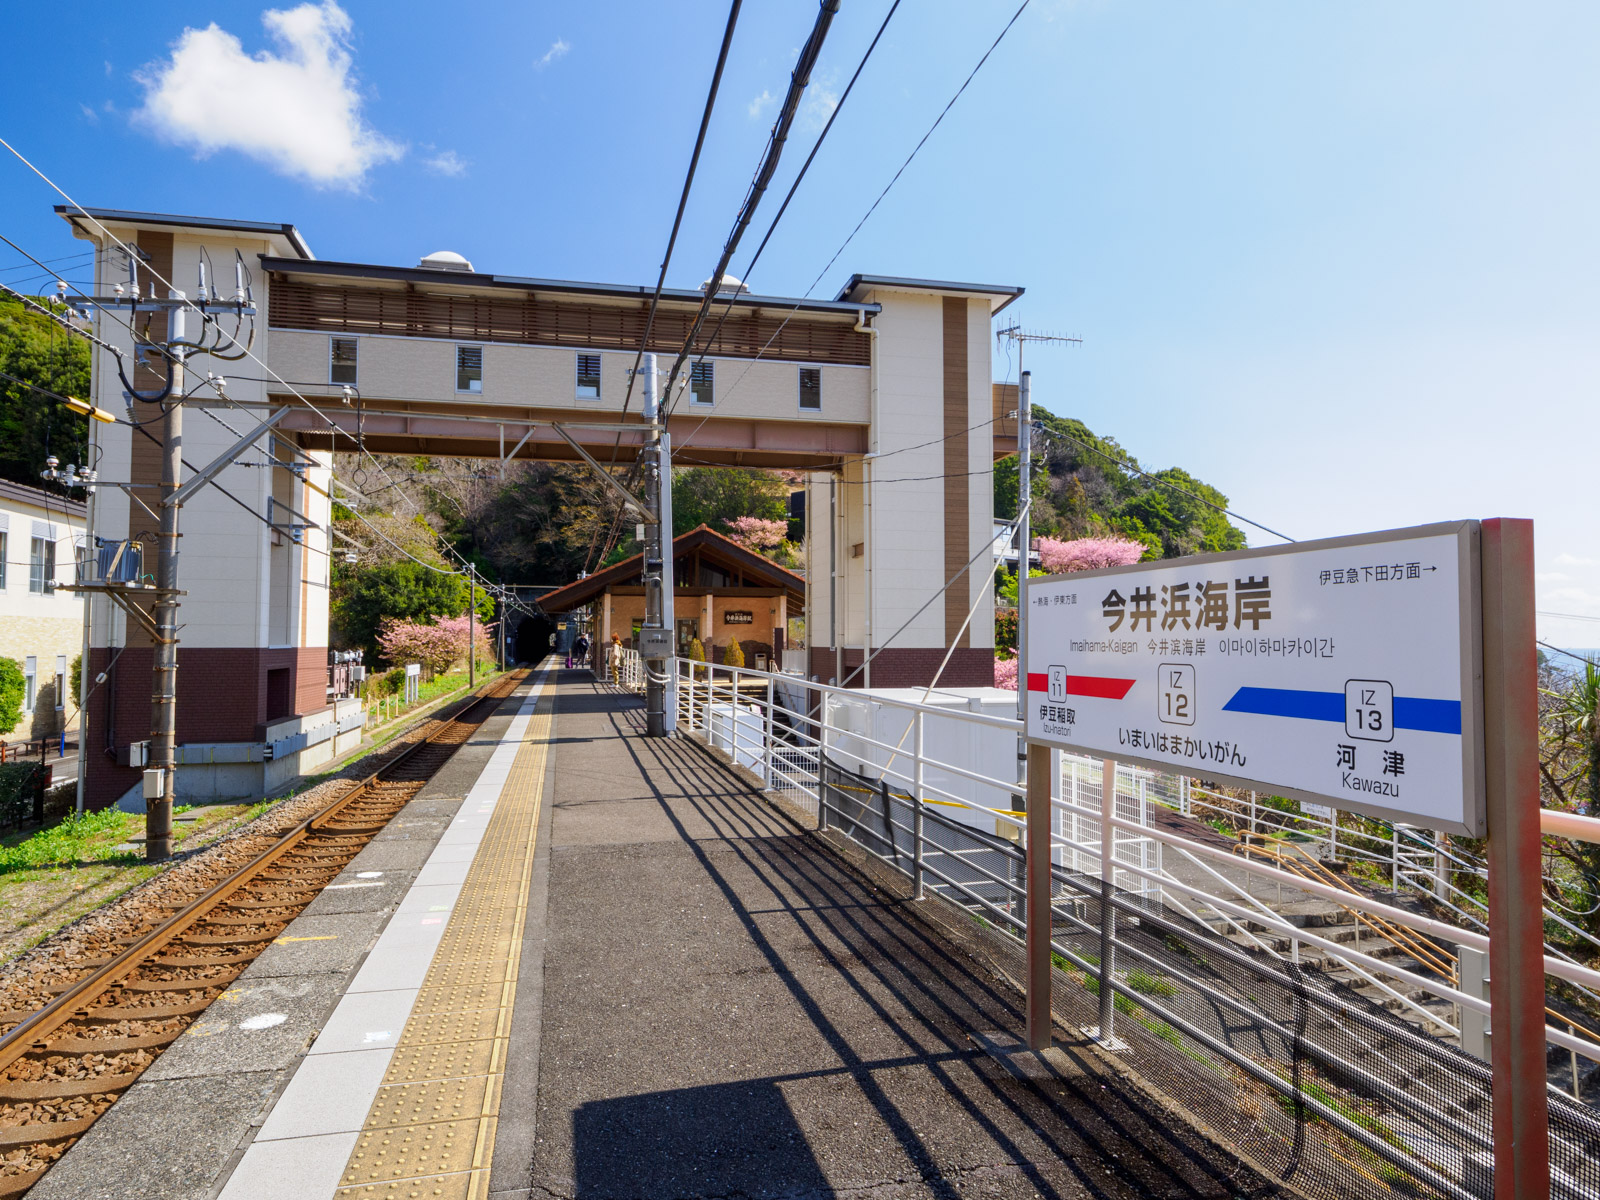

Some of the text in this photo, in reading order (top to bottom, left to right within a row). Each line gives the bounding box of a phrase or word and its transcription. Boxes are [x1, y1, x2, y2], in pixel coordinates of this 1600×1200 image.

[1319, 561, 1420, 586] 伊豆急下田方面
[1101, 575, 1272, 633] 今井浜海岸
[1069, 637, 1335, 658] Imaihama-Kaigan 今井滨海岸 이마이하마카이간
[1053, 671, 1061, 682] IZ
[1170, 671, 1183, 689] IZ
[1052, 683, 1062, 697] 11
[1361, 689, 1376, 706] IZ
[1039, 704, 1076, 725] 伊豆稲取
[1165, 692, 1188, 718] 12
[1043, 722, 1072, 737] Izu-Inatori
[1355, 708, 1382, 731] 13
[1118, 727, 1247, 767] いまいはまかいがん
[1342, 771, 1400, 798] Kawazu
